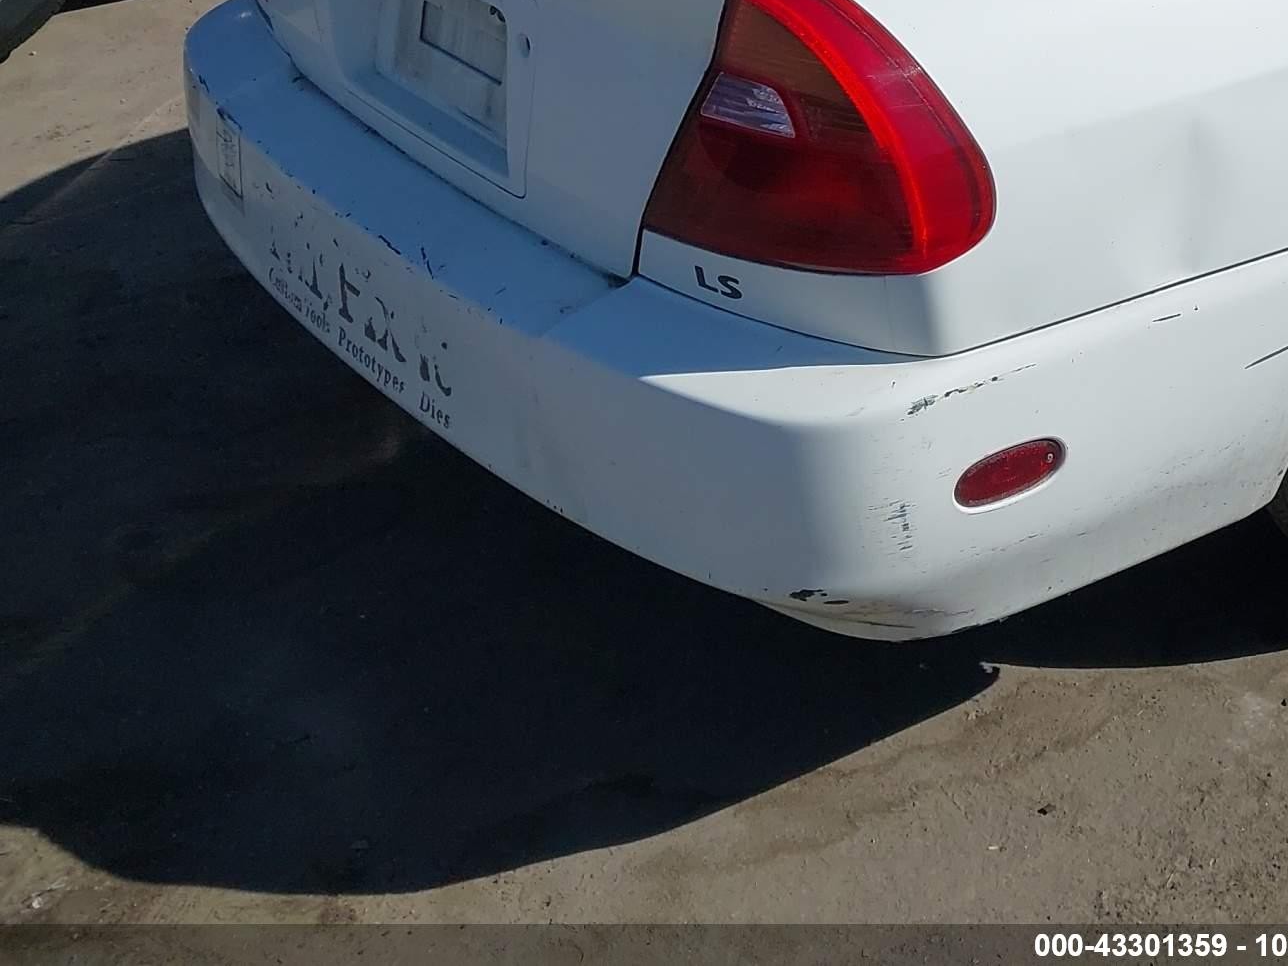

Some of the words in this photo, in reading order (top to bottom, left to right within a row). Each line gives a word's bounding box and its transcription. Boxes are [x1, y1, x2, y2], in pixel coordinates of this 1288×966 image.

[694, 265, 743, 300] LS
[337, 325, 407, 394] Prototypes
[418, 390, 452, 430] Dies
